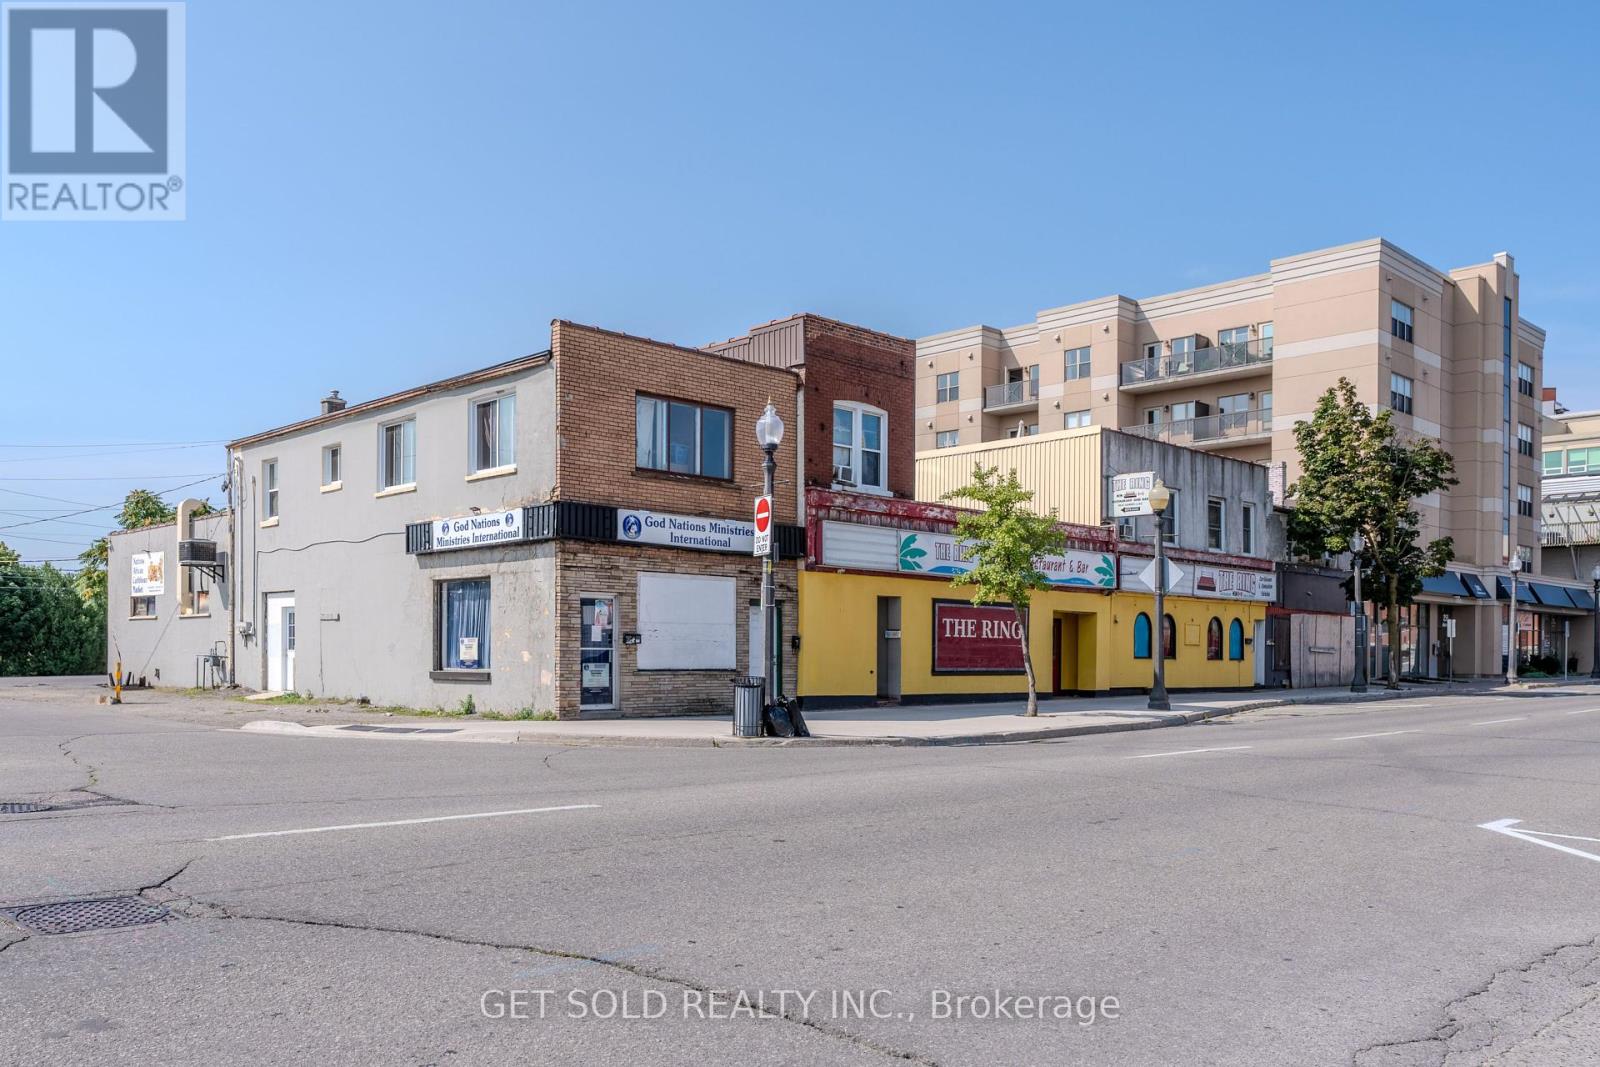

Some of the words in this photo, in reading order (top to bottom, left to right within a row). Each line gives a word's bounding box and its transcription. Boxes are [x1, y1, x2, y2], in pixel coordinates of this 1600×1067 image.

[1112, 479, 1127, 492] THE
[1129, 476, 1151, 490] RING
[453, 520, 469, 533] God
[470, 518, 501, 530] Nations
[644, 515, 666, 529] God
[668, 518, 706, 532] Nations
[709, 522, 754, 537] Ministries
[436, 535, 471, 548] Ministries
[472, 526, 520, 543] International
[670, 531, 731, 548] International
[756, 536, 761, 544] DO
[756, 544, 768, 552] ENTER
[934, 542, 951, 561] THE
[1076, 560, 1089, 574] Bar
[1218, 569, 1235, 593] THE
[1236, 571, 1257, 596] RING
[942, 618, 977, 638] THE
[981, 620, 1022, 639] RING
